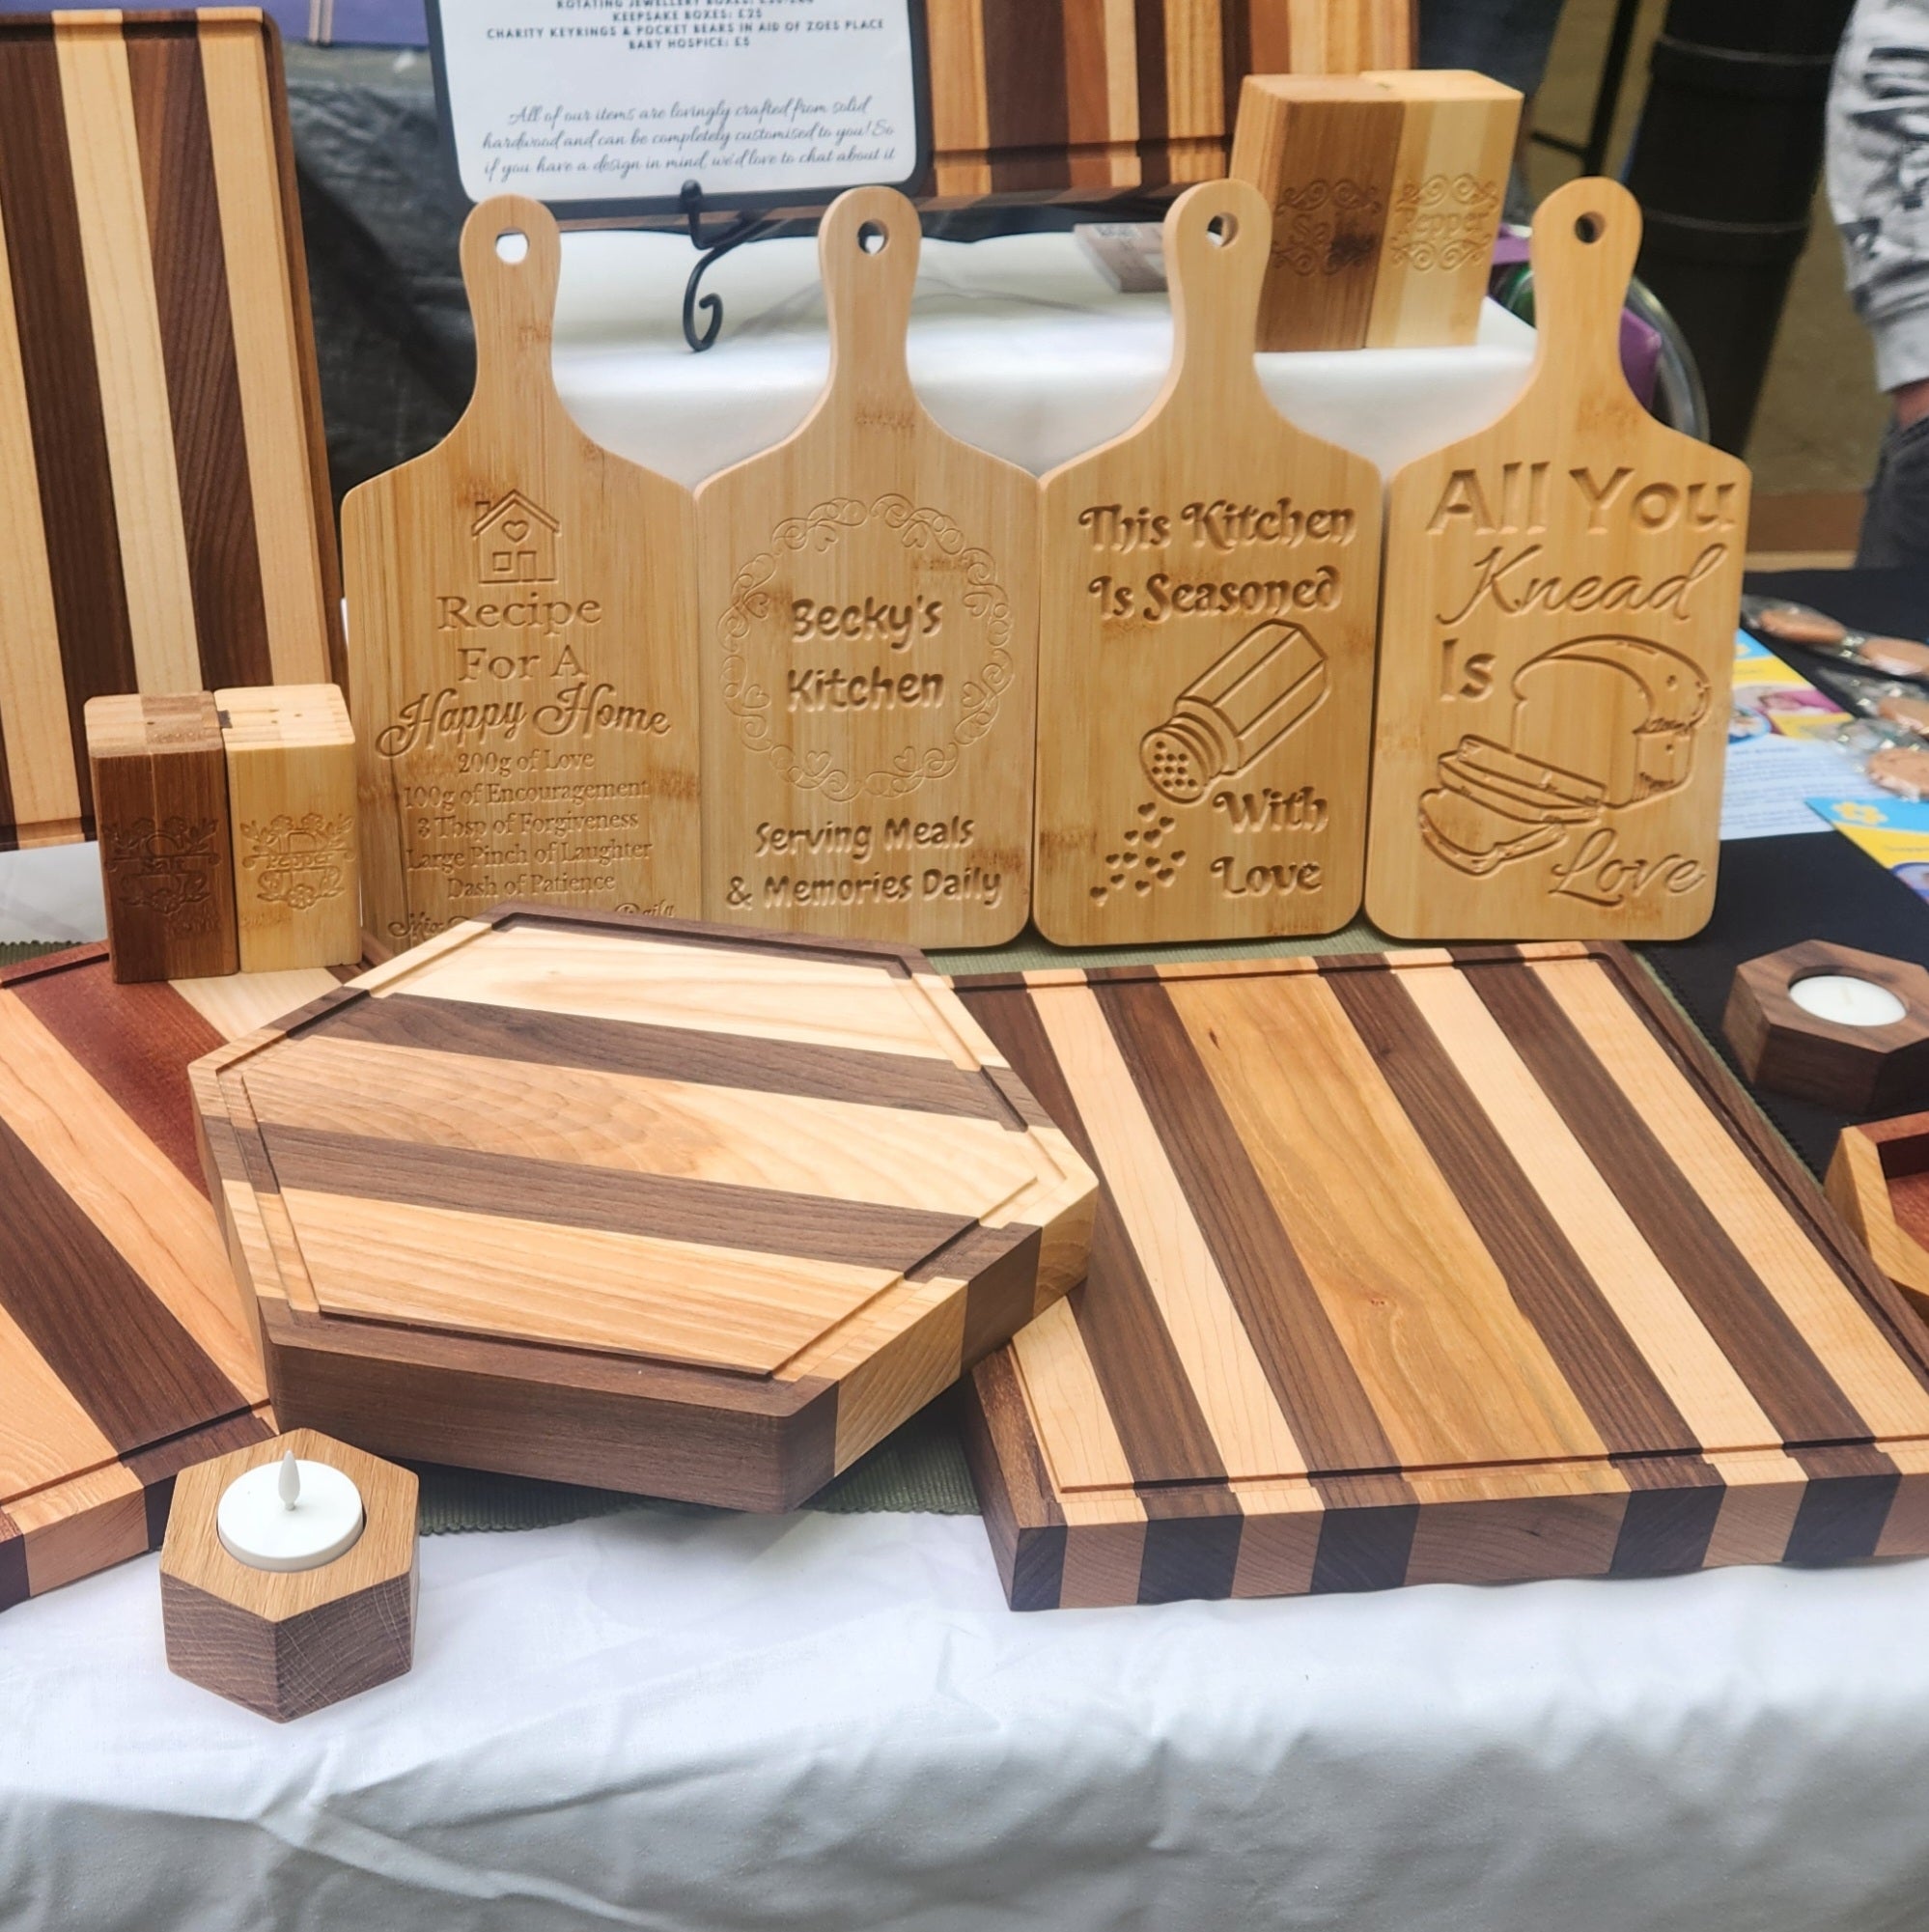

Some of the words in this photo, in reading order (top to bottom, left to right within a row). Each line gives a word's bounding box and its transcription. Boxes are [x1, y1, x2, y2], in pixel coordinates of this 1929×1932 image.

[487, 27, 545, 40] CHARITY
[550, 26, 617, 37] KEYRINGS
[623, 26, 630, 36] &
[637, 24, 686, 35] POCKET
[694, 23, 735, 33] BEARS
[740, 22, 753, 32] IN
[759, 22, 780, 32] AID
[785, 21, 800, 32] OF
[807, 20, 840, 31] ZOES
[846, 19, 884, 30] PLACE
[613, 12, 679, 22] KEEPSAKE
[685, 10, 732, 19] BOXES:
[739, 9, 763, 18] £25
[629, 40, 662, 49] BABY
[668, 38, 729, 48] HOSPICE:
[735, 37, 750, 47] £5
[483, 128, 565, 149] hardwood
[564, 128, 600, 148] and
[599, 136, 627, 146] can
[631, 127, 648, 144] be
[653, 120, 731, 150] completely
[736, 122, 820, 142] customised
[819, 125, 832, 138] to
[836, 120, 873, 147] you!
[873, 119, 895, 137] So
[509, 105, 542, 126] All
[545, 104, 564, 130] of
[565, 110, 592, 122] our
[596, 107, 635, 121] items
[639, 108, 666, 120] are
[671, 99, 731, 126] lovingly
[736, 98, 795, 124] crafted
[792, 98, 827, 123] from
[833, 95, 873, 114] solid
[485, 157, 500, 182] if
[502, 165, 530, 182] you
[537, 155, 573, 173] have
[577, 162, 588, 173] a
[593, 153, 641, 180] design
[646, 155, 660, 170] in
[713, 149, 749, 168] we'd
[748, 149, 777, 165] love
[781, 152, 795, 164] to
[799, 148, 833, 163] chat
[837, 146, 881, 162] about
[883, 147, 896, 160] it
[1425, 461, 1551, 535] All
[1569, 465, 1737, 535] You
[1078, 499, 1172, 552] This
[1181, 497, 1356, 552] Kitchen
[1088, 574, 1134, 619] Is
[1143, 565, 1343, 624] Seasoned
[1436, 543, 1729, 626] Knead
[435, 592, 602, 637] Recipe
[791, 595, 943, 653] Becky's
[458, 647, 541, 683] For
[550, 644, 590, 679] A
[1439, 638, 1496, 702] Is
[787, 666, 946, 713] Kitchen
[375, 687, 528, 758] Happy
[533, 682, 672, 740] Home
[458, 752, 513, 778] 200g
[517, 752, 540, 771] of
[544, 749, 596, 770] Love
[404, 785, 456, 812] 100g
[461, 783, 488, 805] of
[487, 779, 650, 806] Encouragement
[1212, 786, 1330, 833] With
[418, 817, 430, 839] 3
[433, 816, 488, 843] Tbsp
[493, 812, 518, 835] of
[520, 810, 639, 838] Forgiveness
[755, 820, 873, 863] Serving
[884, 815, 975, 851] Meals
[405, 848, 465, 874] Large
[470, 844, 530, 869] Pinch
[535, 842, 560, 865] of
[560, 840, 653, 868] Laughter
[1210, 856, 1324, 899] Love
[1548, 827, 1708, 907] Love
[448, 877, 499, 900] Dash
[504, 875, 529, 895] of
[532, 872, 616, 896] Patience
[726, 875, 753, 910] &
[764, 869, 913, 909] Memories
[922, 865, 1003, 908] Daily
